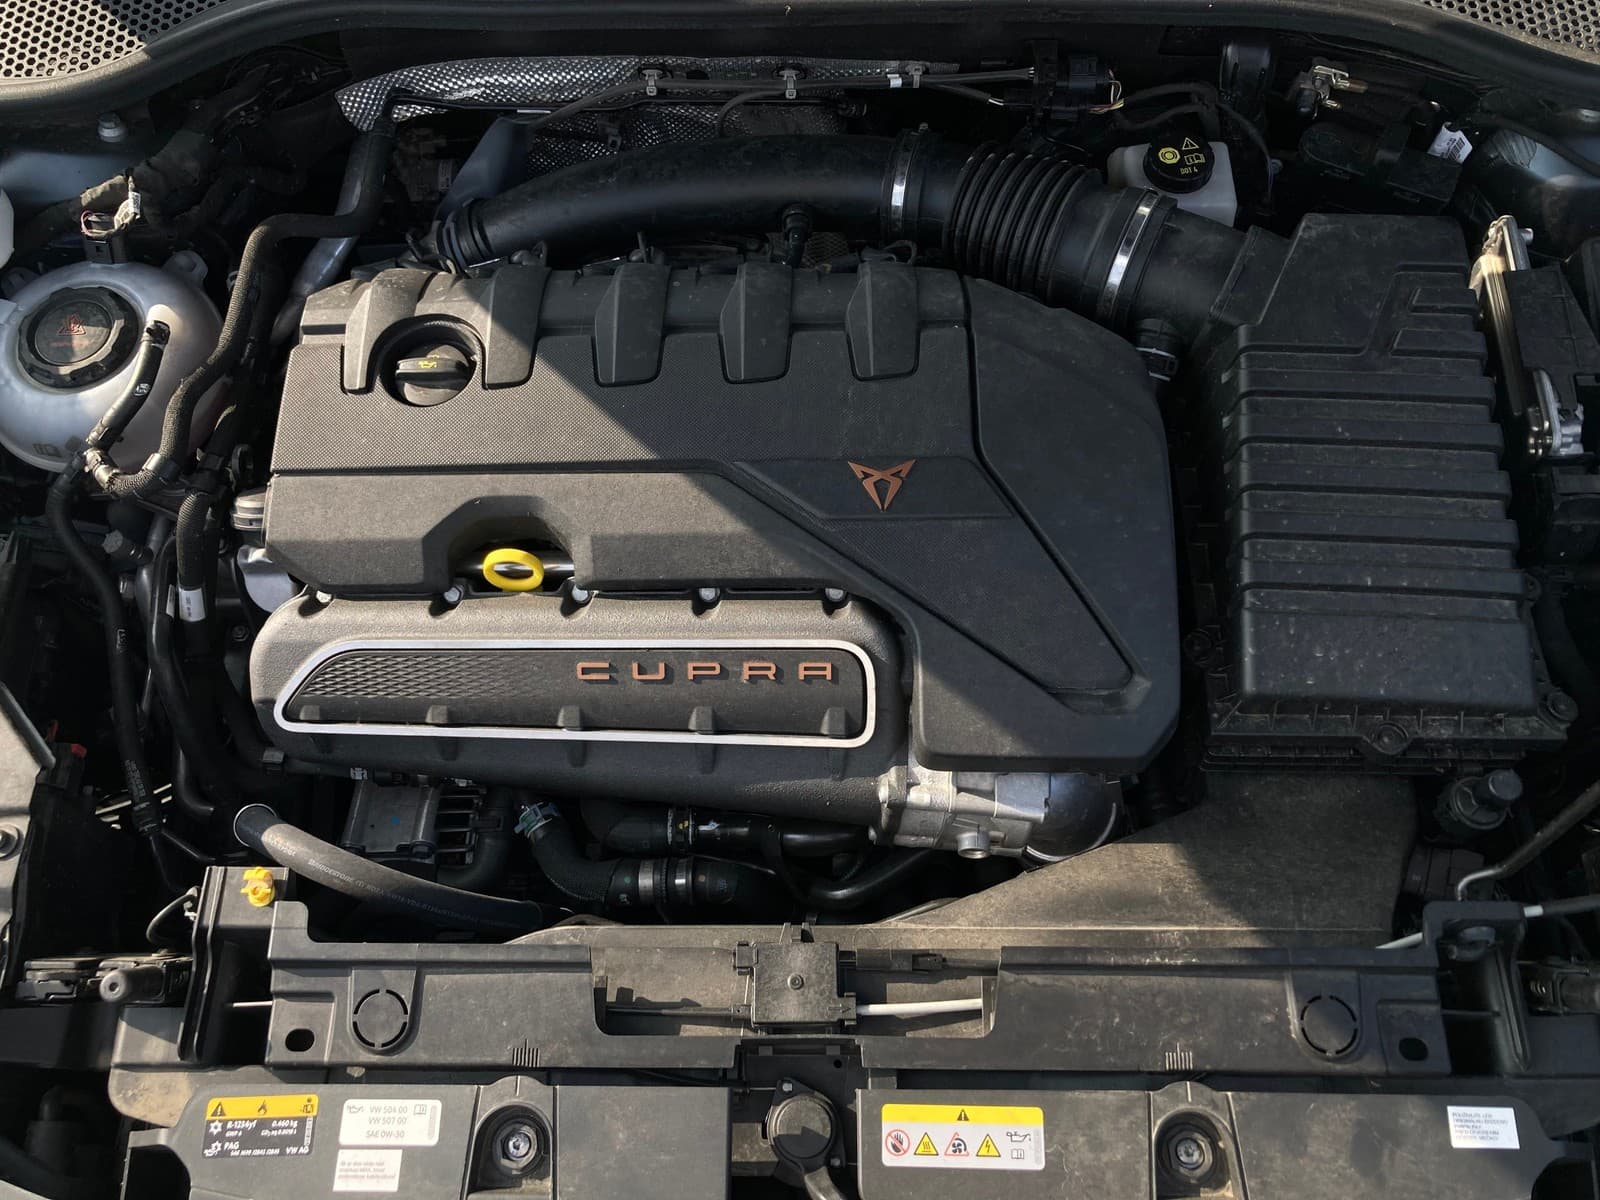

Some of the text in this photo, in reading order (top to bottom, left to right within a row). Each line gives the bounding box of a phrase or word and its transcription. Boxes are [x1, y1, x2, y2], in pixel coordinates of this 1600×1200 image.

[1180, 167, 1192, 175] DOT
[576, 661, 832, 681] CUPRA
[369, 1105, 382, 1113] VW
[398, 1105, 408, 1113] 00
[368, 1116, 407, 1125] VW 507 00
[366, 1129, 405, 1138] SAE 0W-30
[224, 1141, 240, 1150] PAG
[286, 1147, 298, 1155] VW
[298, 1146, 310, 1154] AG
